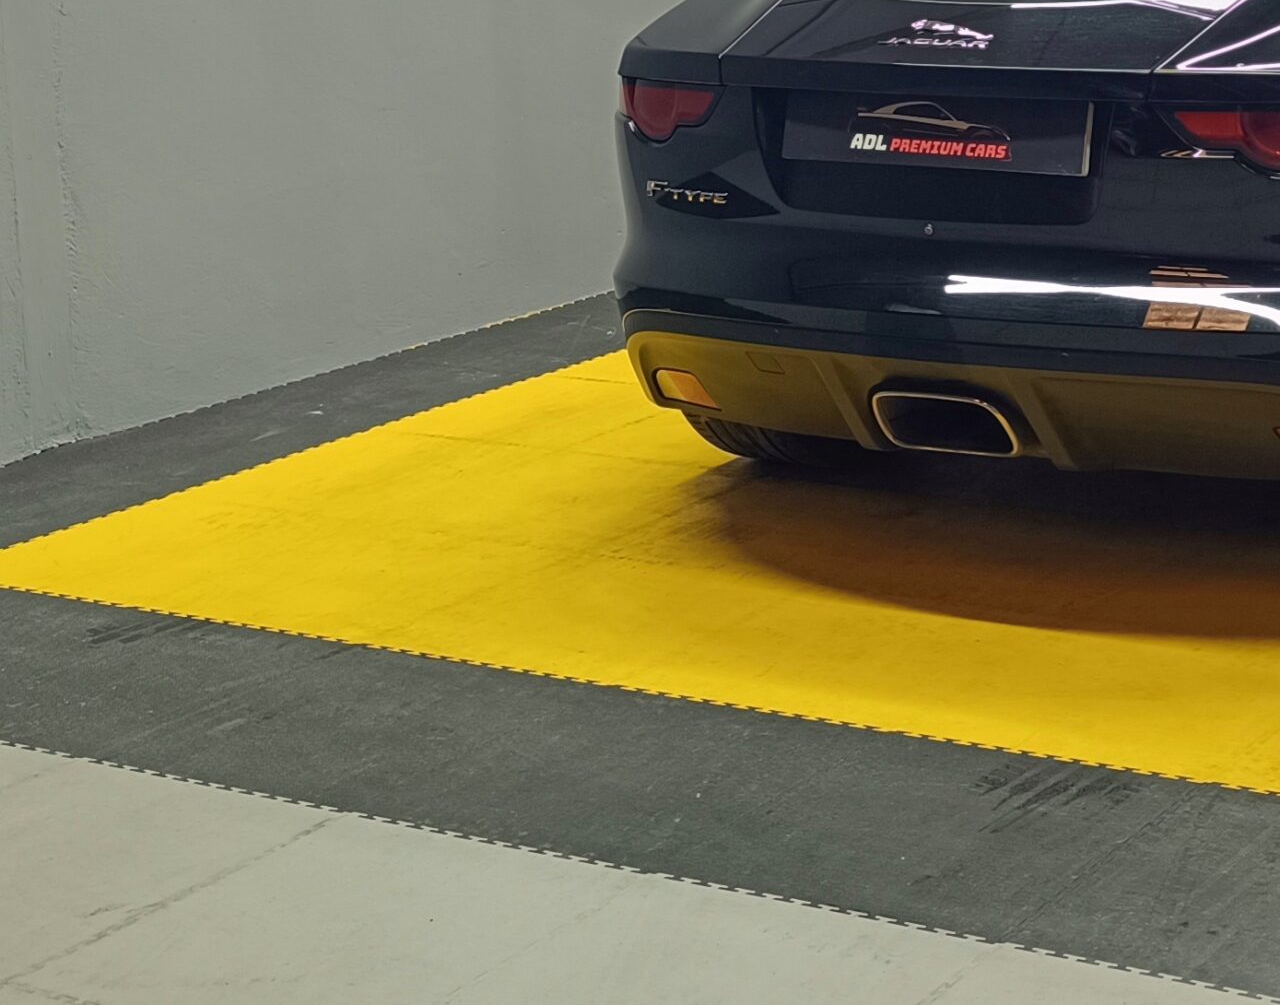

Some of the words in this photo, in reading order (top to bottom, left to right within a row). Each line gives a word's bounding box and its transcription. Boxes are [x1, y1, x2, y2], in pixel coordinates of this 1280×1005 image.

[877, 37, 990, 49] JAGUAR
[850, 133, 887, 152] ADL
[889, 138, 963, 156] PREMIUM
[965, 143, 1008, 159] CARS
[646, 180, 729, 204] F-TYPE
